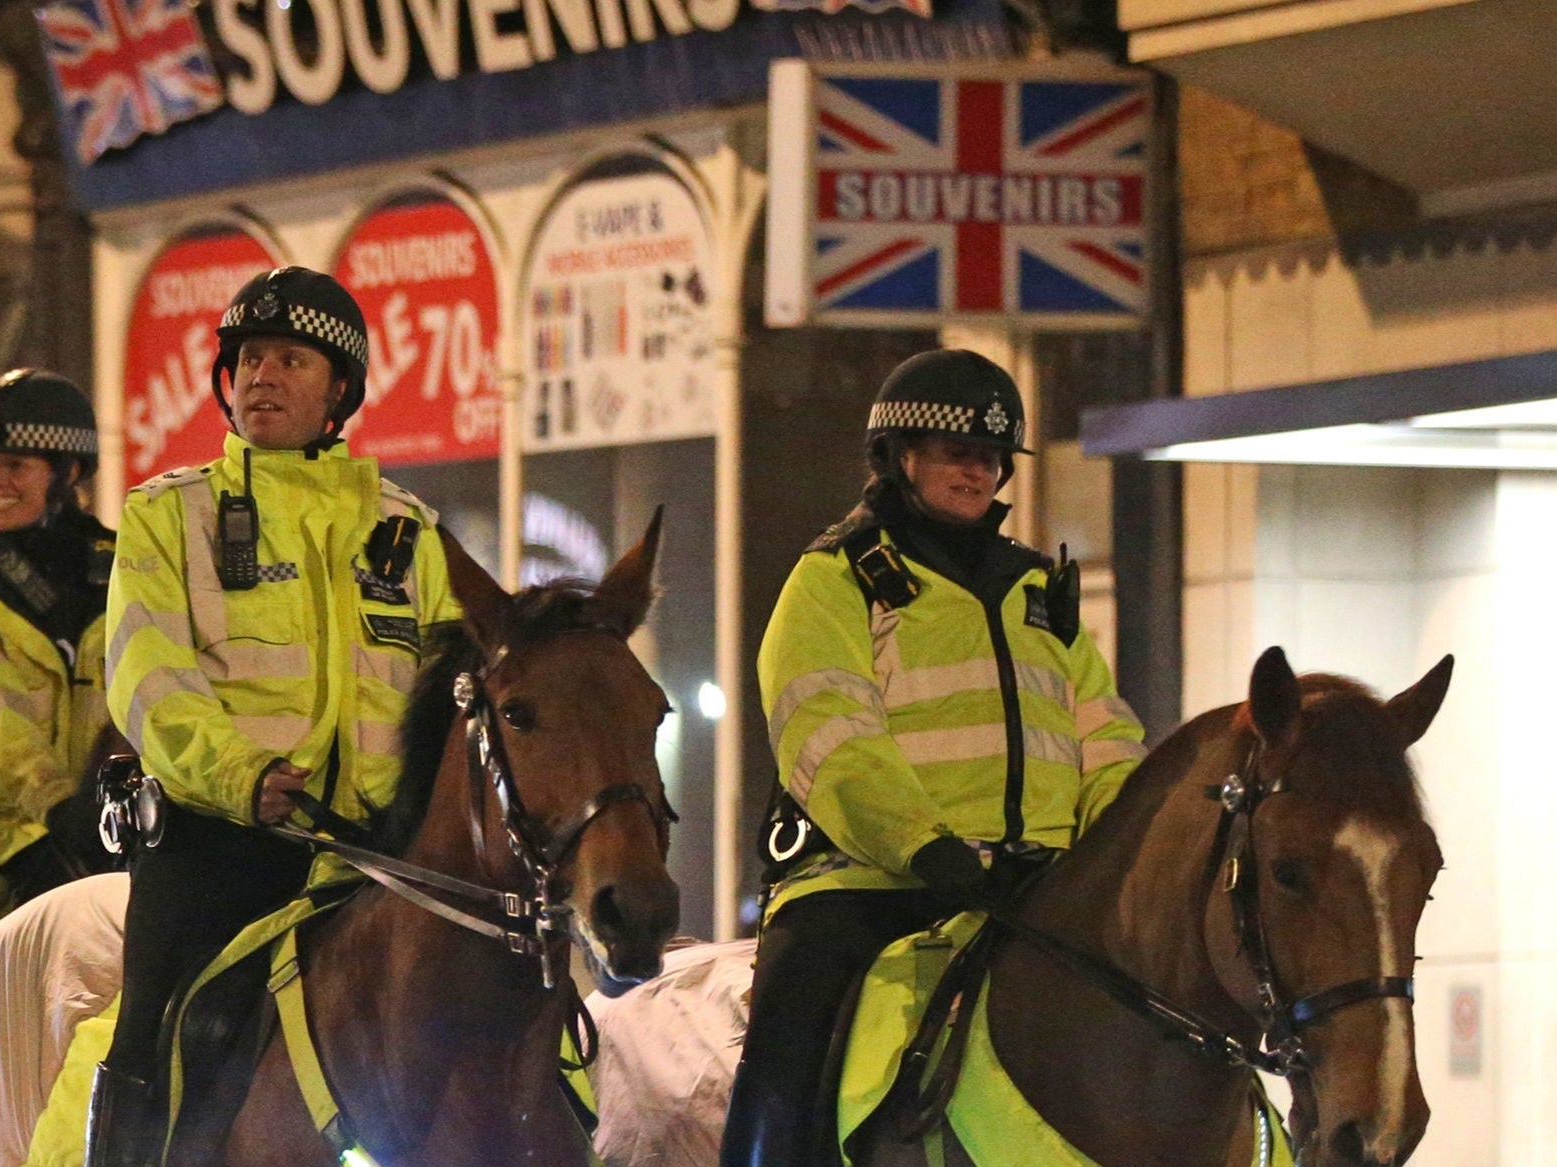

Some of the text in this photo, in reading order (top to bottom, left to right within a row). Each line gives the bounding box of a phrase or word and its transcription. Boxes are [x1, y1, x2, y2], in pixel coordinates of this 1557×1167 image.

[217, 0, 745, 114] SOUVEN
[834, 172, 1124, 226] SOUVENIRS
[348, 232, 478, 290] SOUVENIRS
